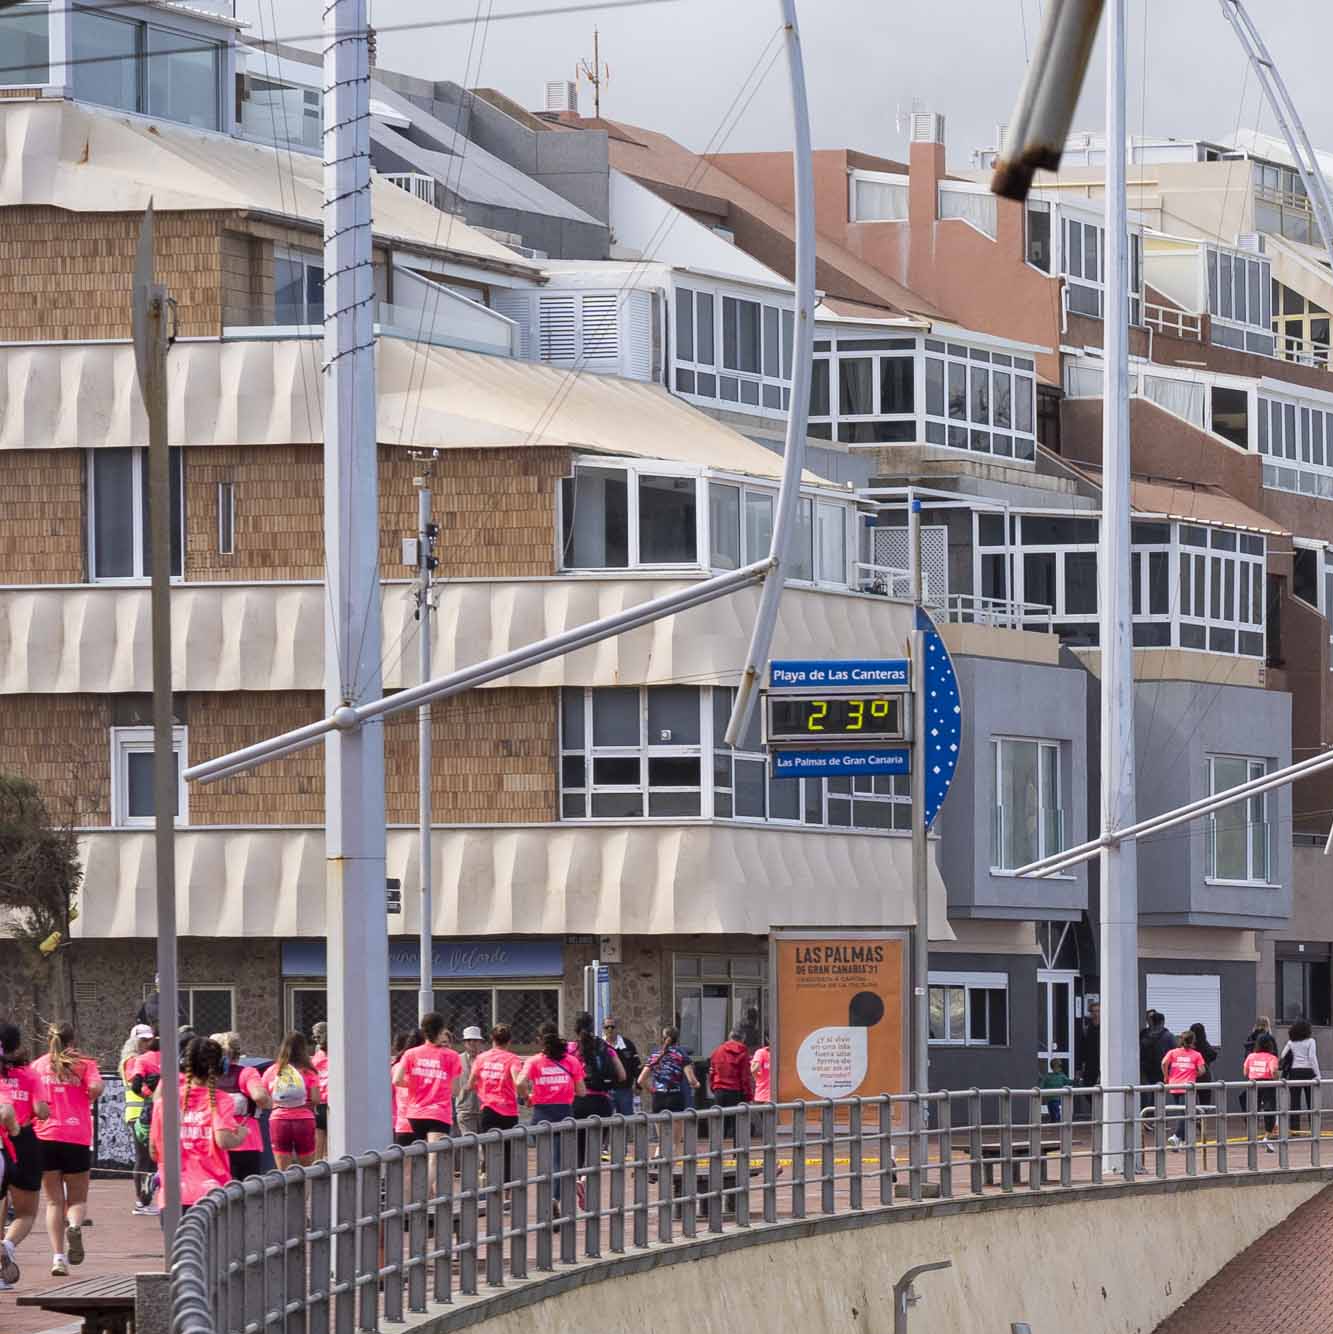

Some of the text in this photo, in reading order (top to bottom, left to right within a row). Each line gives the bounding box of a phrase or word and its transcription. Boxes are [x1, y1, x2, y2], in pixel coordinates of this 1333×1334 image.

[773, 668, 905, 683] Playa de Las Canteras
[777, 755, 903, 767] Las Palmas de Gran Canaria
[796, 946, 884, 964] LAS PALMAS
